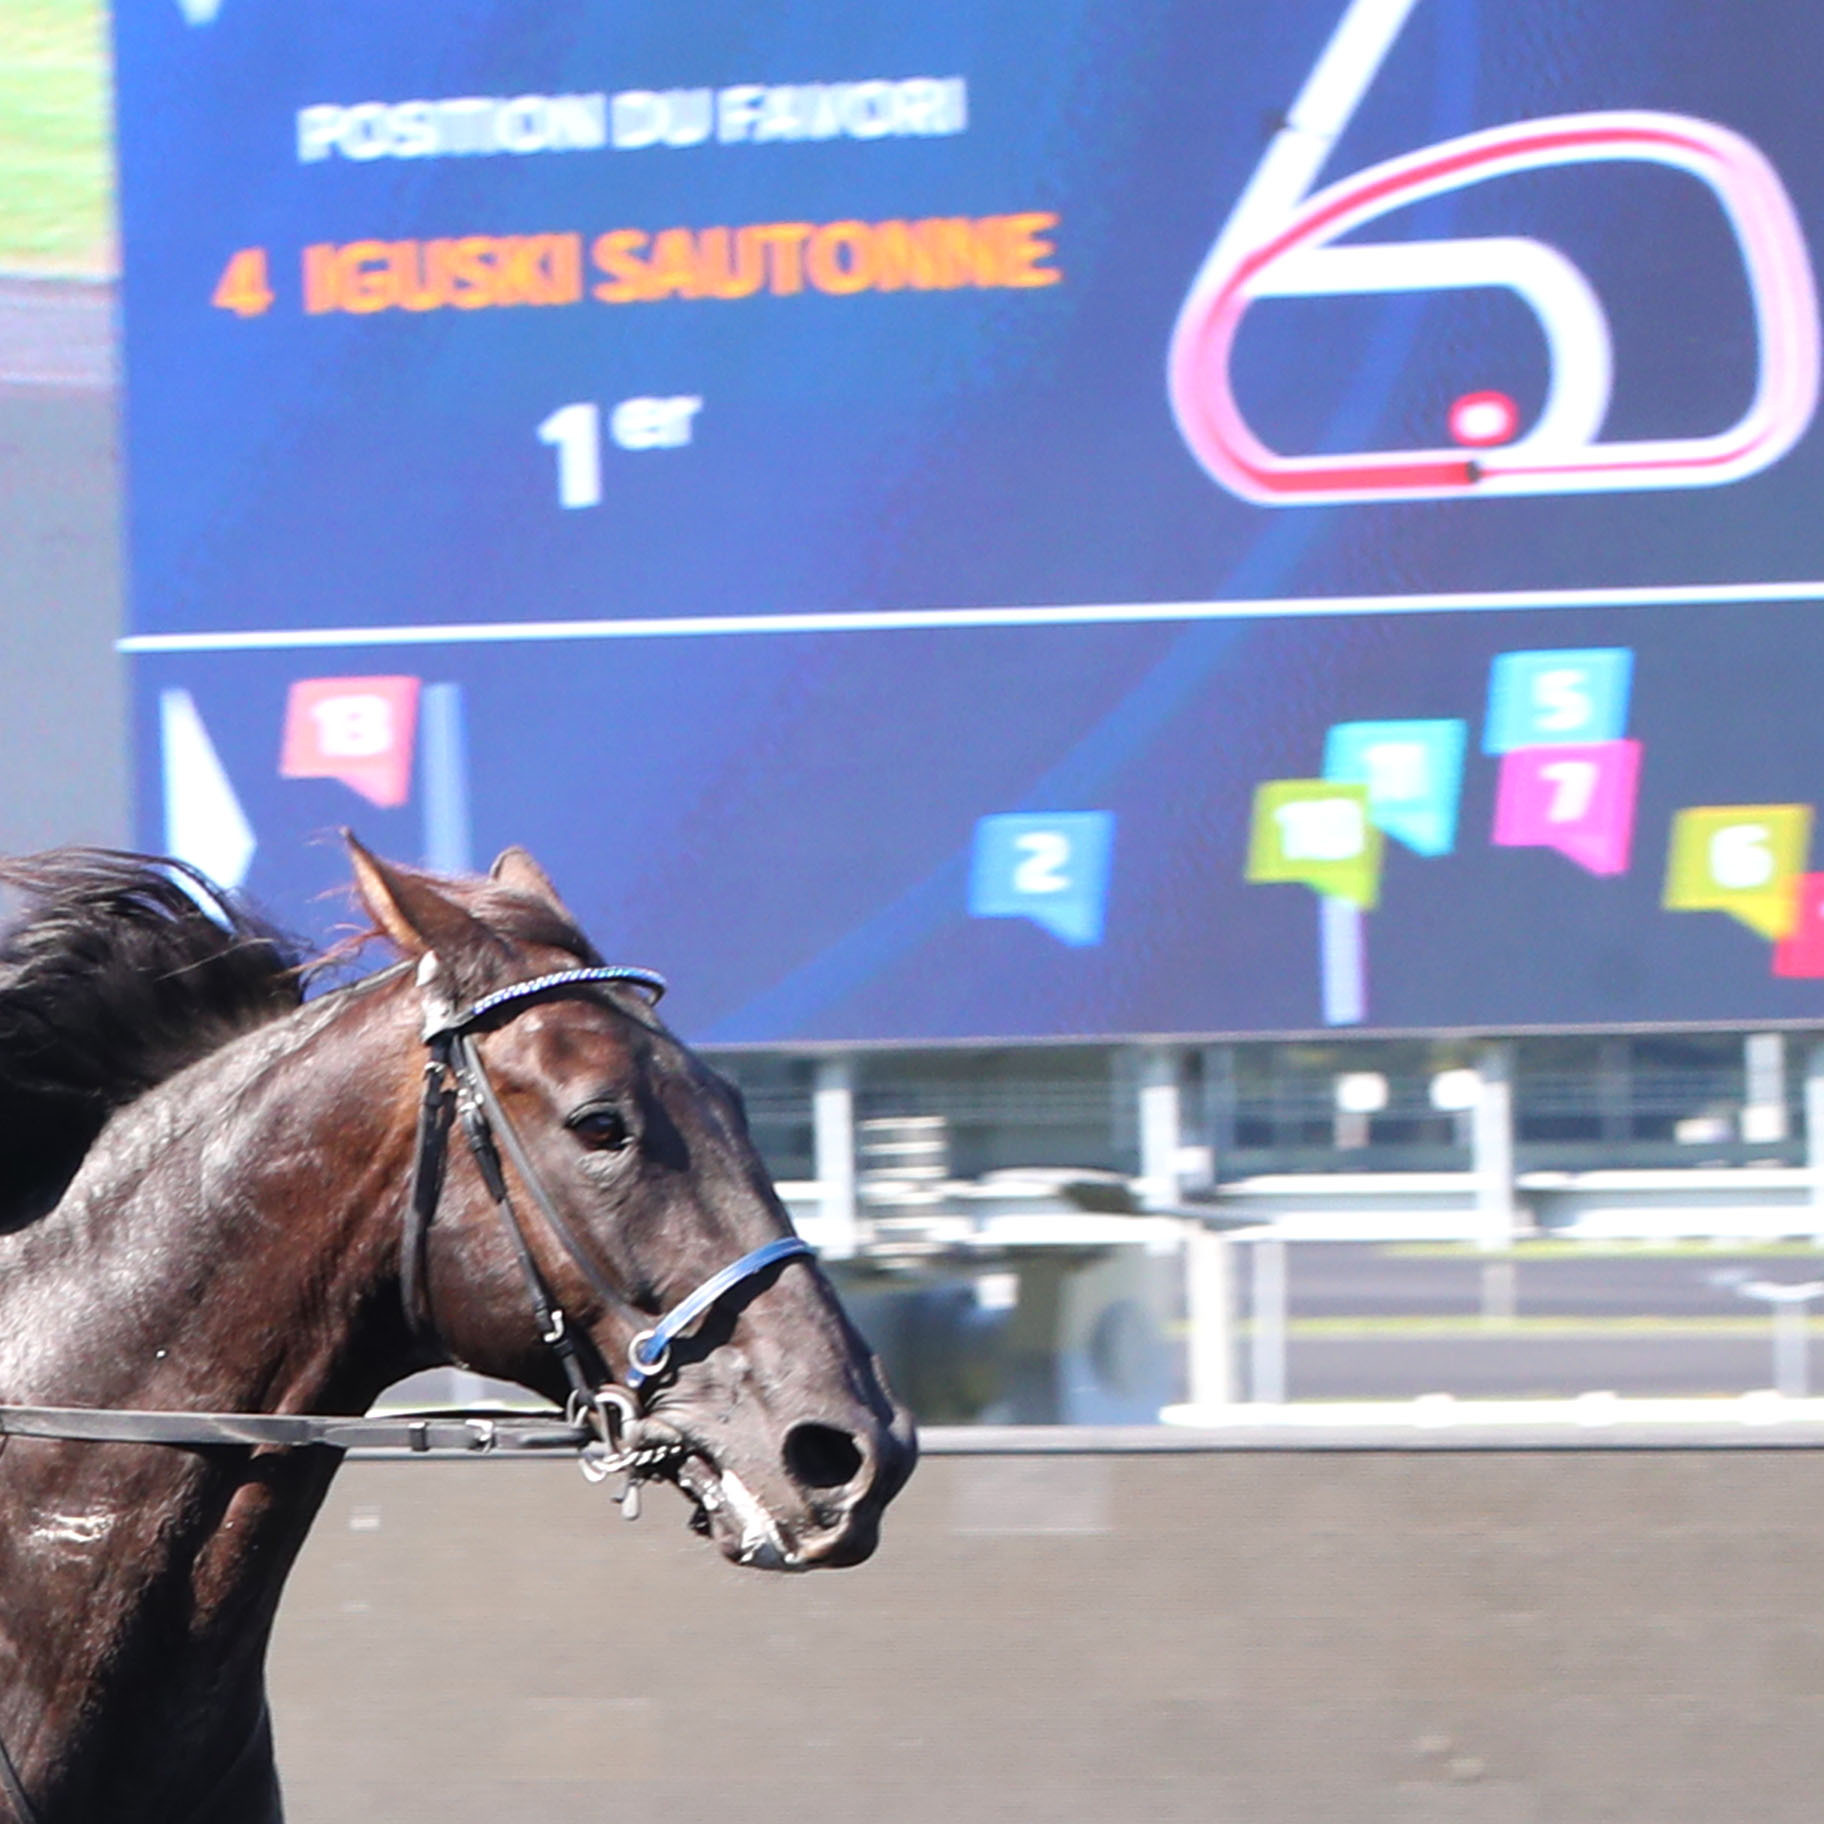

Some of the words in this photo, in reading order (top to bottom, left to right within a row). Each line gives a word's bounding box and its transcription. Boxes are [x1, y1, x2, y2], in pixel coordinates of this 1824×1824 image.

[297, 92, 606, 163] POSITION
[610, 87, 713, 149] DU
[716, 76, 967, 144] FAVORI
[215, 249, 273, 315] 4
[303, 232, 582, 313] IGUSKI
[592, 211, 1062, 303] SAUTONNE
[1532, 669, 1592, 731] 5
[1540, 760, 1599, 823] 7
[1013, 831, 1072, 892] 2
[1708, 824, 1775, 889] 6
